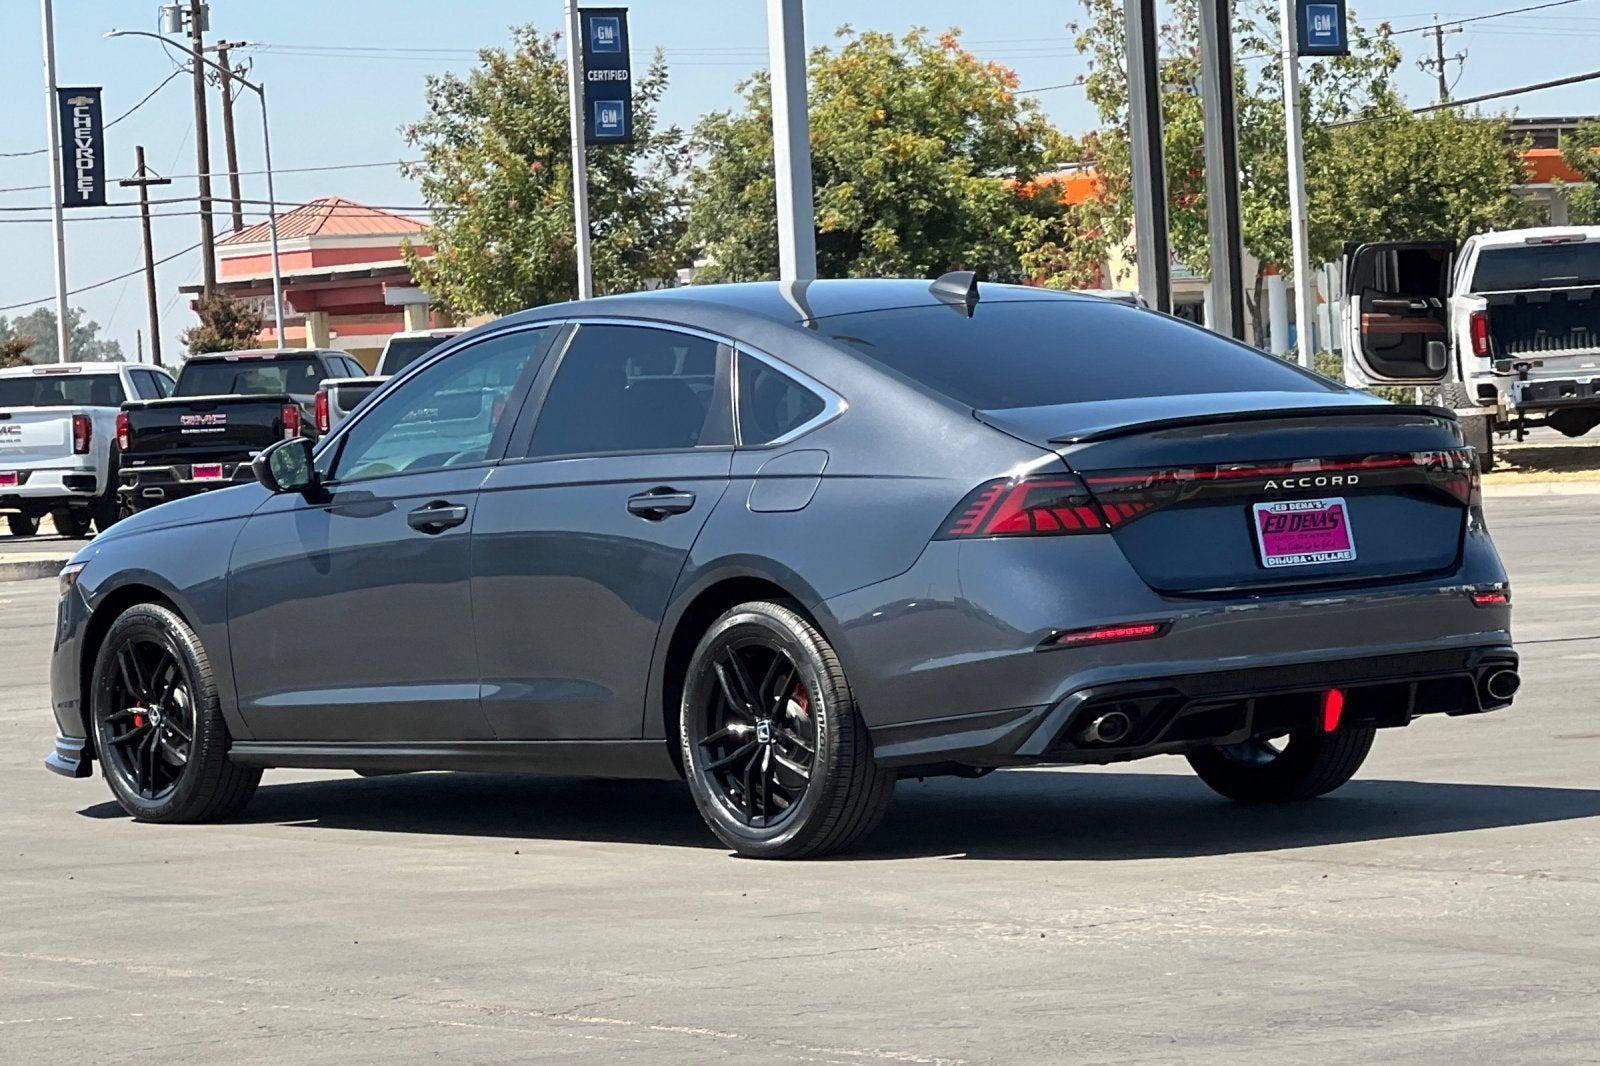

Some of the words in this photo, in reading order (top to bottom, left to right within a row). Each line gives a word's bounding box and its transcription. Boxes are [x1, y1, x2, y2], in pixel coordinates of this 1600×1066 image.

[1314, 15, 1331, 31] GM
[597, 25, 613, 40] GM
[587, 69, 629, 82] CERTIFIED
[601, 109, 618, 124] GM
[73, 106, 95, 200] CHEVROLET
[180, 413, 227, 426] GMC
[1263, 475, 1359, 490] ACCORD
[1275, 503, 1288, 512] ED
[1289, 501, 1322, 511] DENA'S
[1262, 514, 1288, 532] ED
